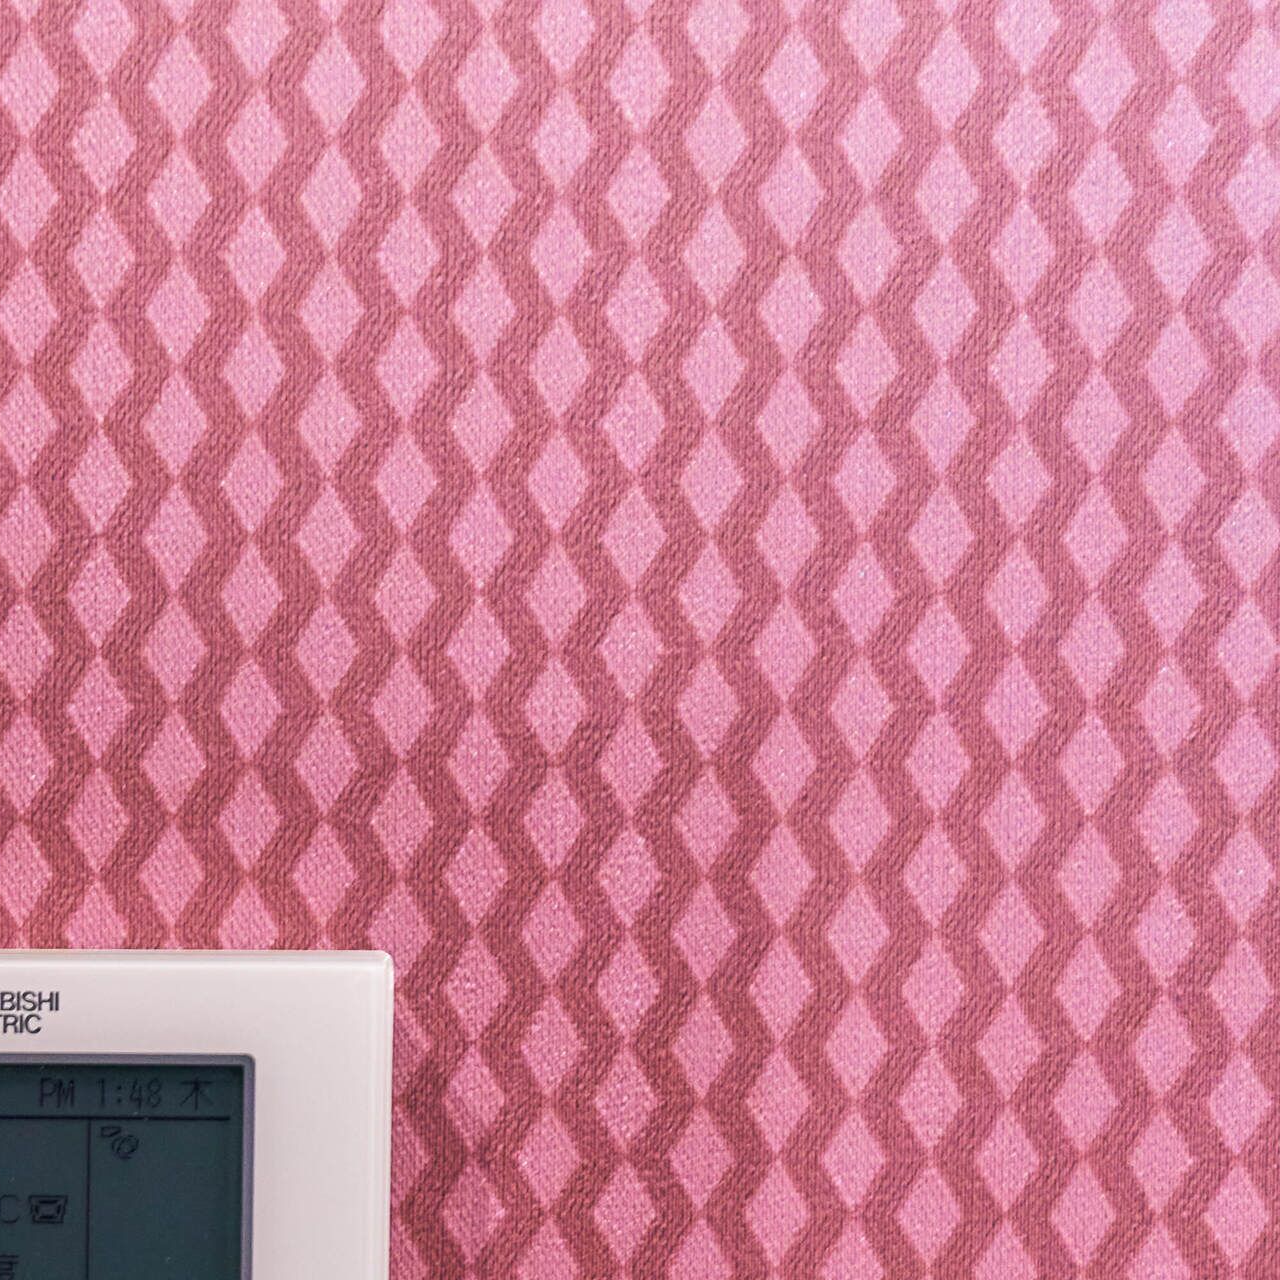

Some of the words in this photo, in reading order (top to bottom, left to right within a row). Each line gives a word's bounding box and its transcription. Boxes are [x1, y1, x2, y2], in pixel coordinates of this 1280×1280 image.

[39, 1077, 76, 1108] PM
[96, 1077, 163, 1108] 1:48
[179, 1076, 214, 1111] 木
